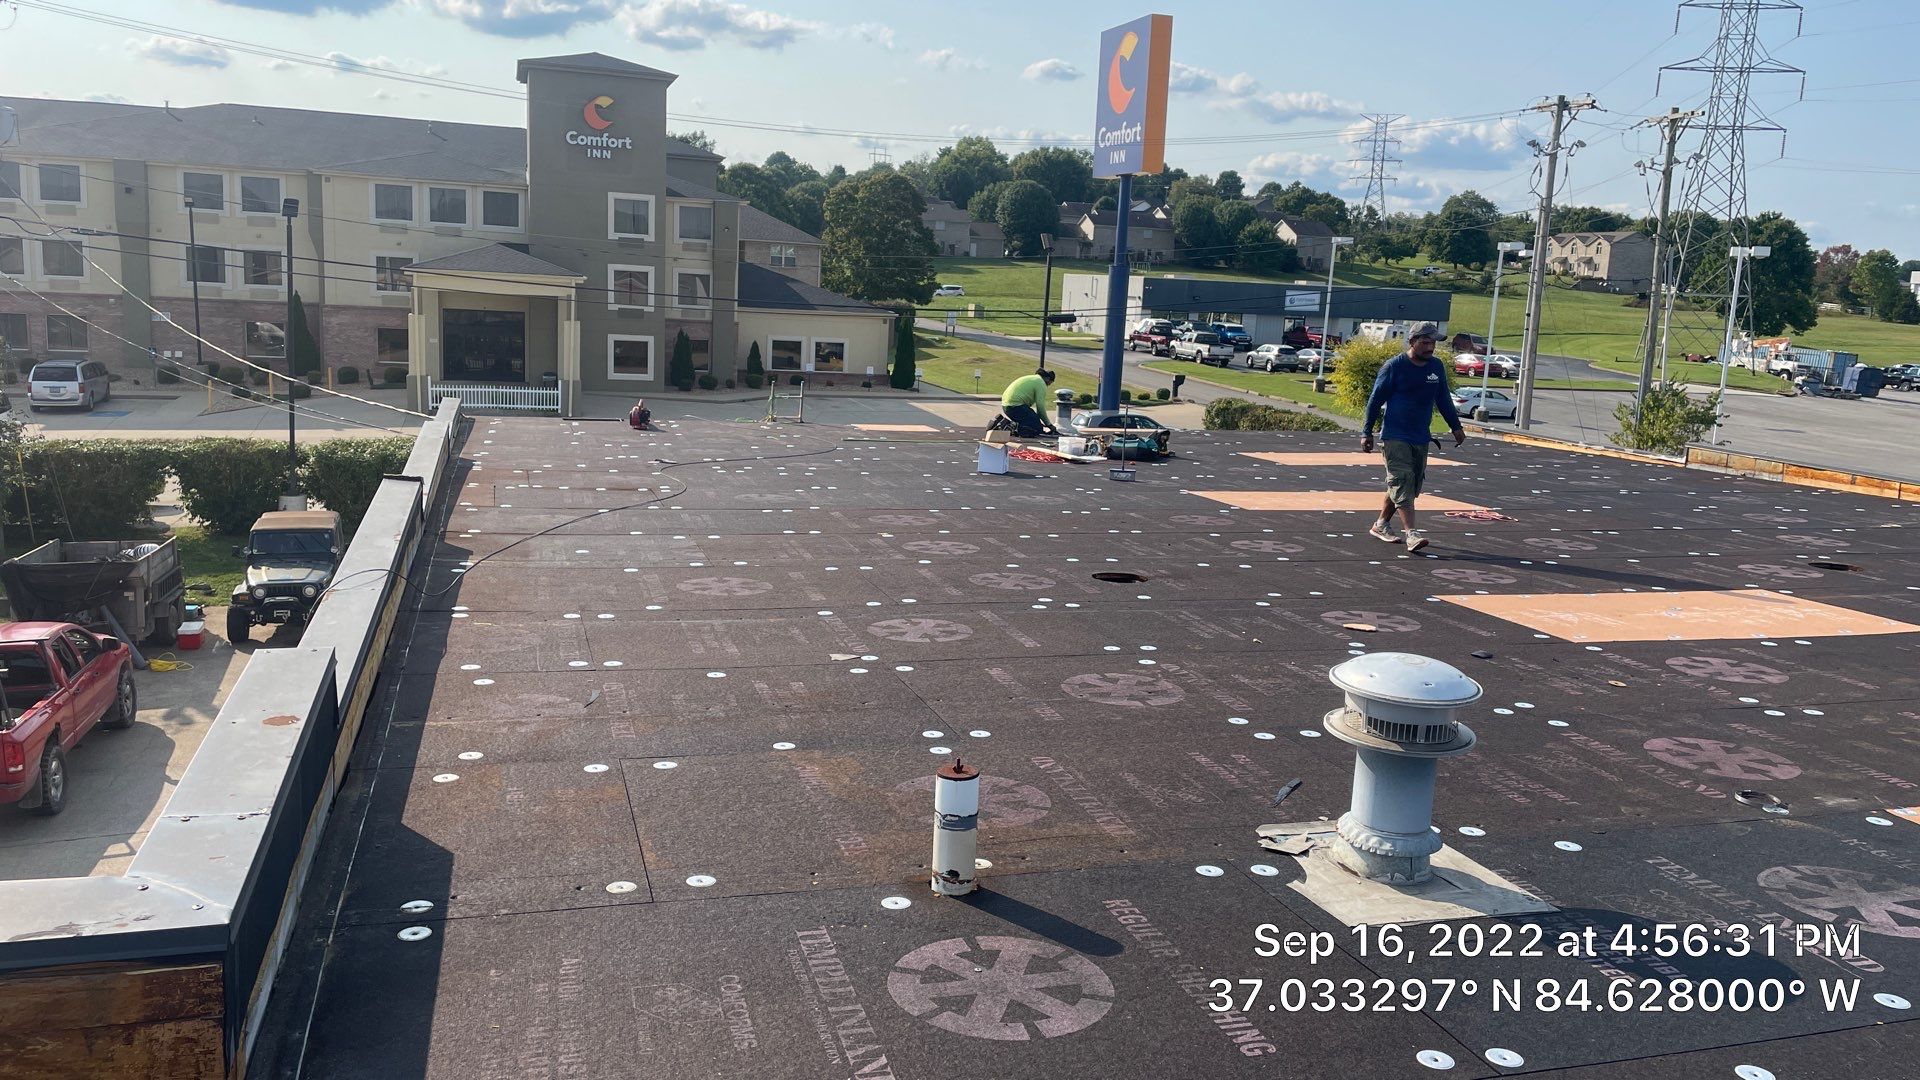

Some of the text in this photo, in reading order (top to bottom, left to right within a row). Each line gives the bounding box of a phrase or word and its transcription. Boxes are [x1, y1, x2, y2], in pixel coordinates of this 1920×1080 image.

[565, 130, 633, 150] Comfort
[1098, 120, 1141, 148] Comfort
[586, 148, 612, 159] INN
[1109, 150, 1126, 164] INN
